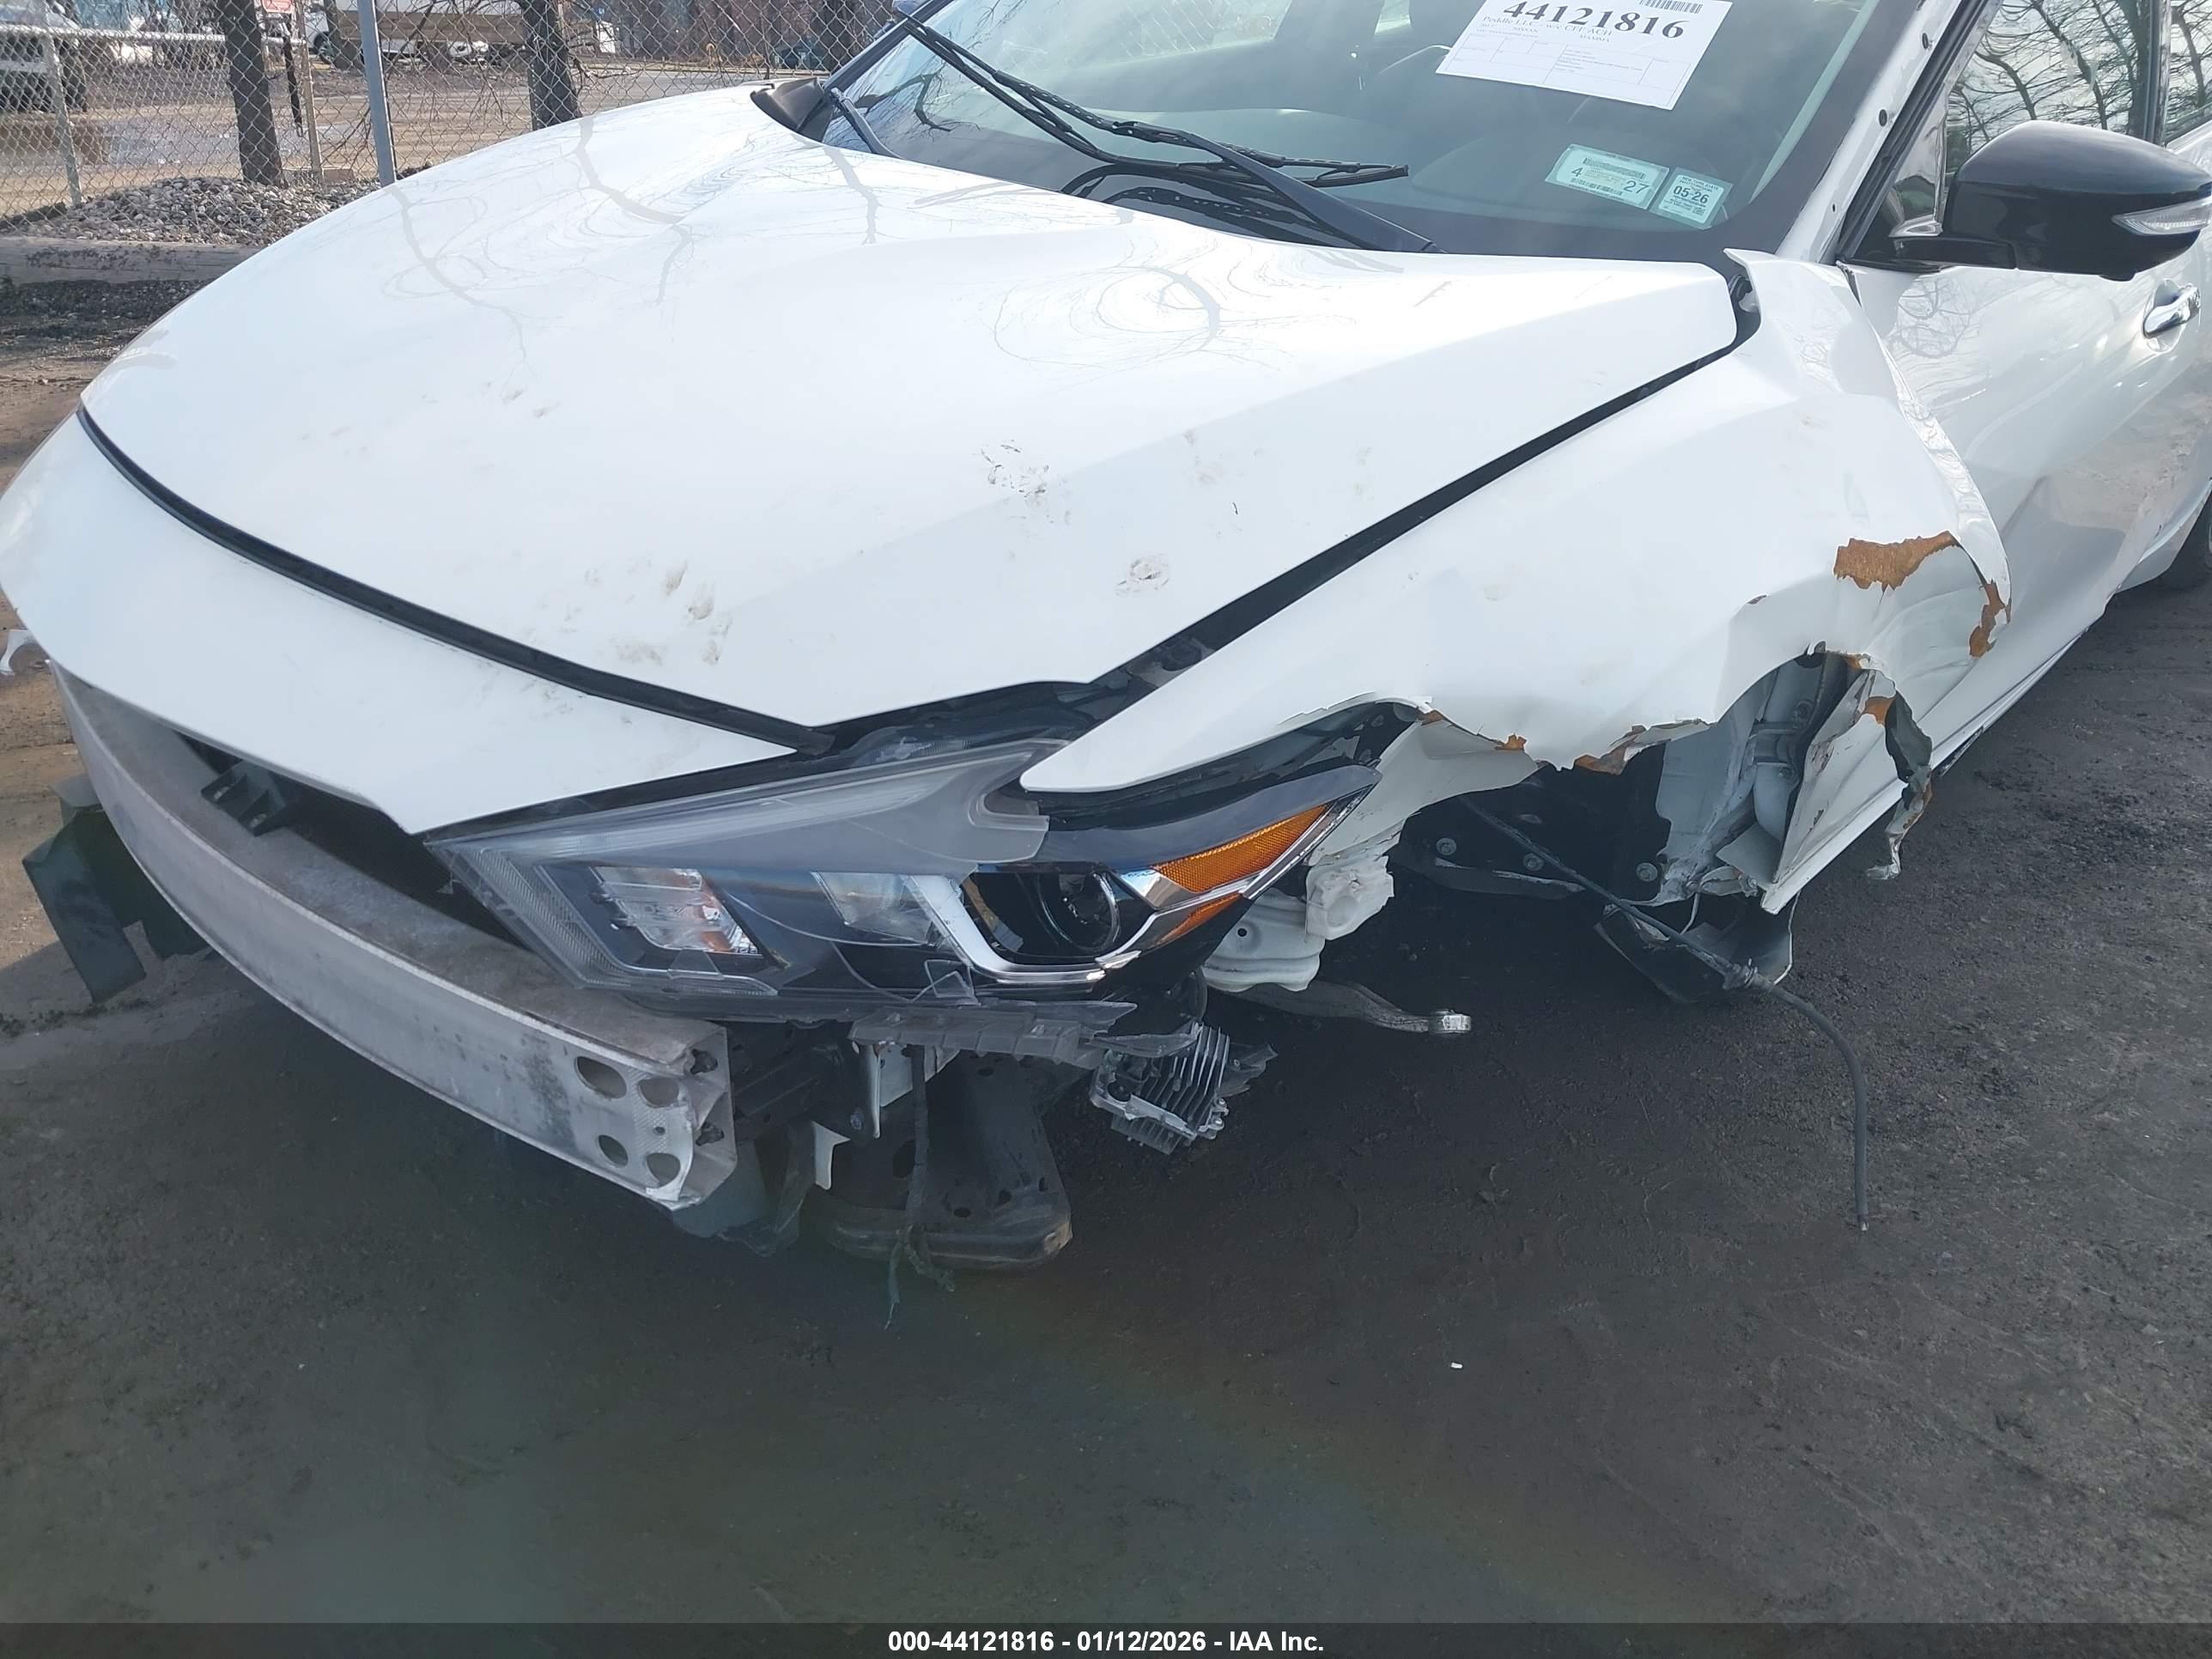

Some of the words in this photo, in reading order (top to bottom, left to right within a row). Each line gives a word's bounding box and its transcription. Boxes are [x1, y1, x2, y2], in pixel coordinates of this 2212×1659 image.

[1503, 1, 1690, 40] 44121816
[1571, 167, 1583, 177] 4
[1624, 180, 1650, 195] 27
[1673, 185, 1711, 204] 05-26
